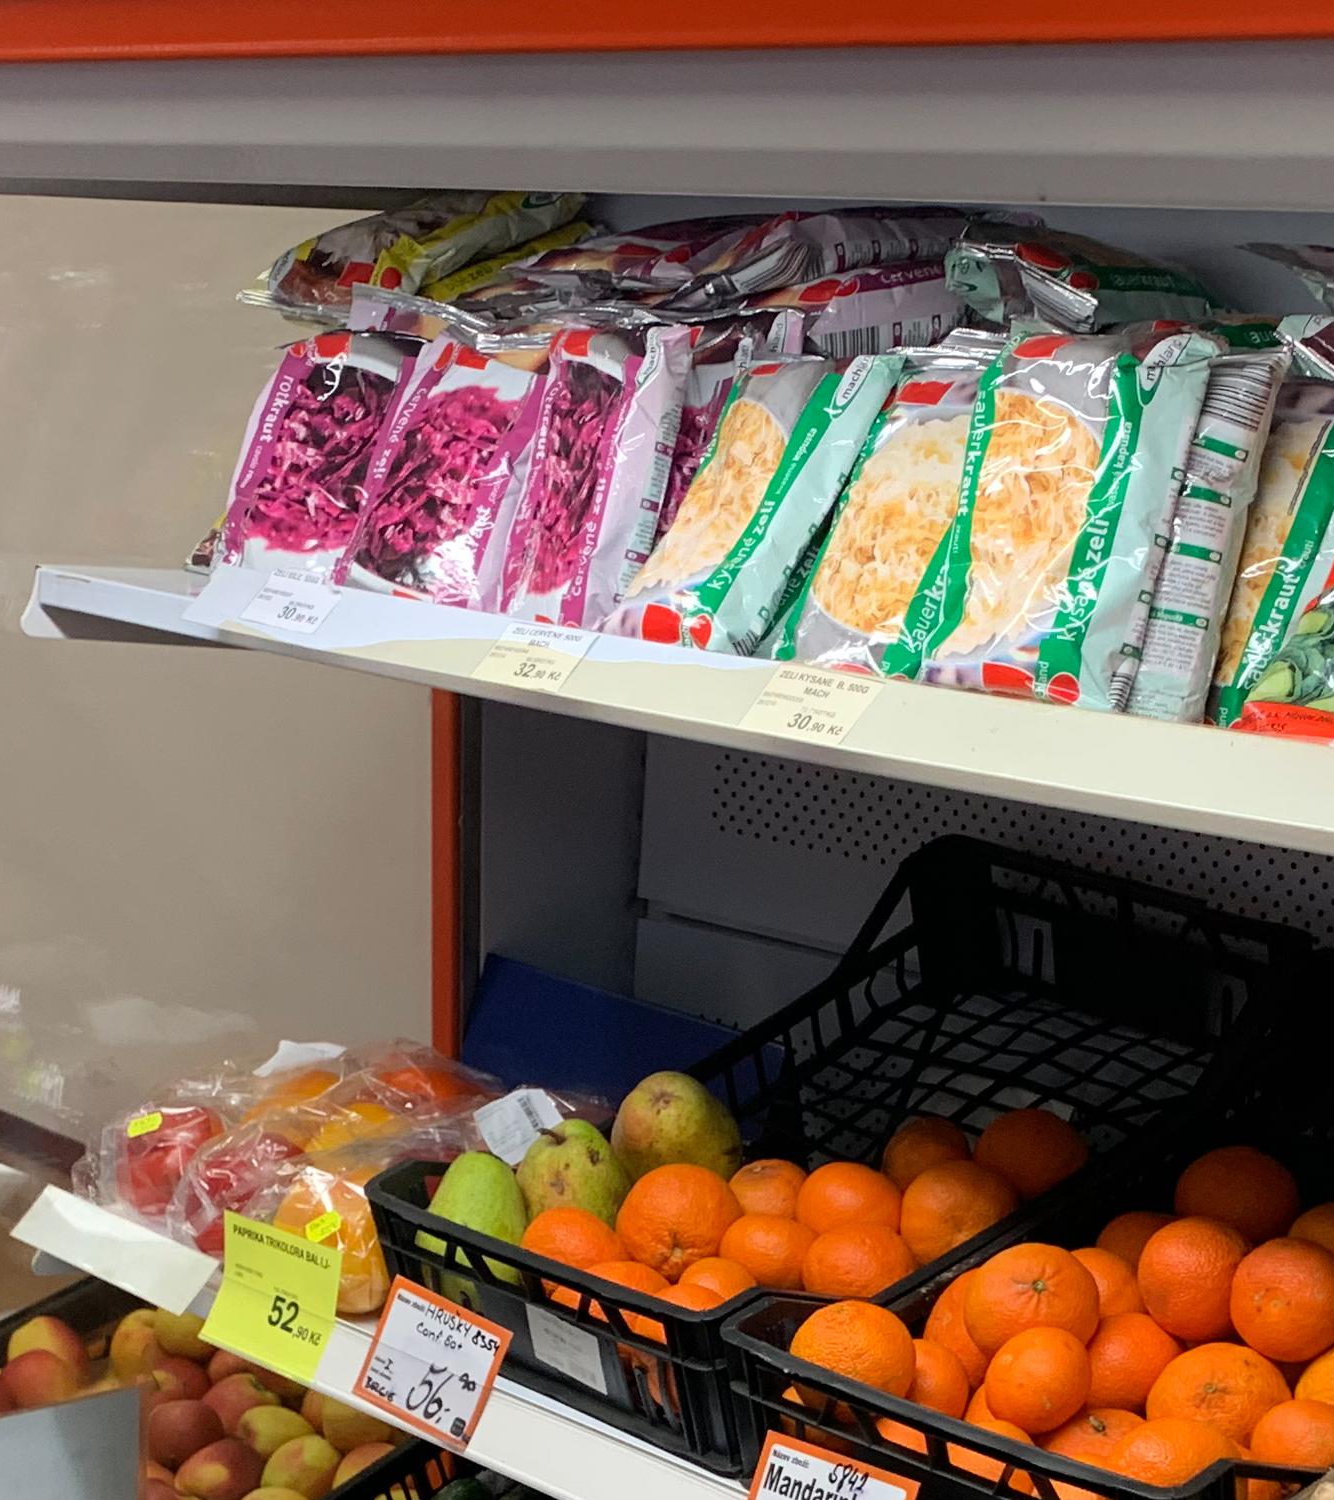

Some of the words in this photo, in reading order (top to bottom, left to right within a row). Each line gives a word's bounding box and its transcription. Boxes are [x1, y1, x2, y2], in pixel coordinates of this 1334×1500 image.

[259, 376, 294, 443] rotkraut
[957, 390, 988, 517] sauerkraut
[707, 537, 756, 590] kysané
[752, 500, 775, 537] zelí
[1085, 520, 1110, 561] zelí
[909, 564, 950, 653] sauerkra
[803, 687, 830, 698] MACH
[827, 726, 844, 736] Kč
[232, 1223, 265, 1245] PAPRIKA
[305, 1249, 319, 1265] BAL
[267, 1295, 308, 1342] 52,90
[309, 1331, 321, 1347] Kč
[424, 1301, 472, 1336] HRUŠKY
